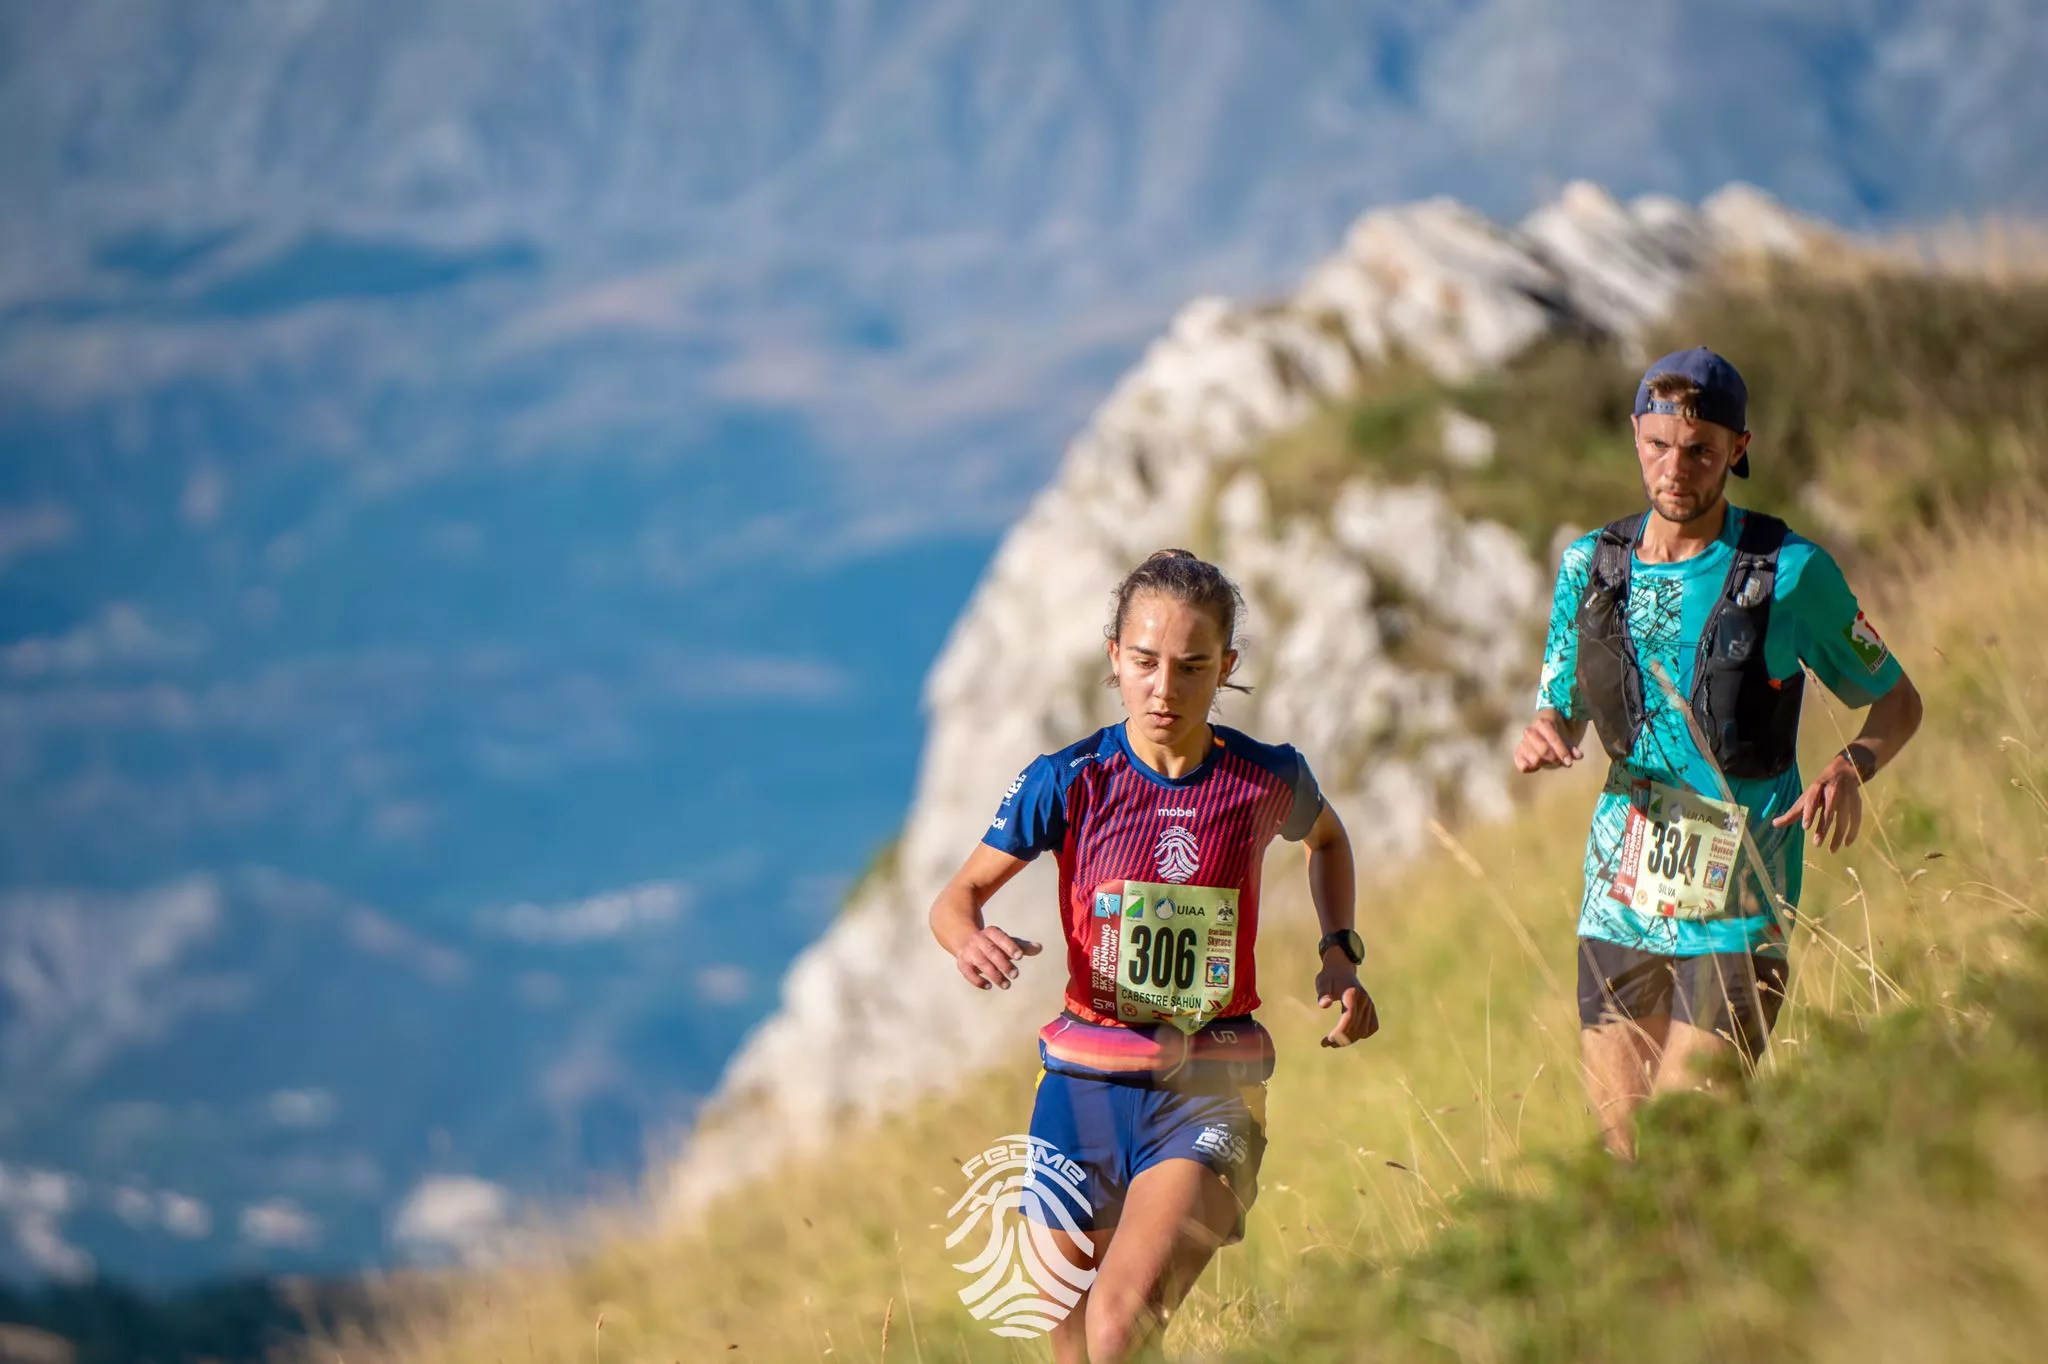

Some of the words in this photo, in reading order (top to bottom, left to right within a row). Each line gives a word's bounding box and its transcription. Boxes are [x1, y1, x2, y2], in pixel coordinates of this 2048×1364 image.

[1158, 807, 1196, 817] mobel
[1648, 821, 1702, 886] 334
[1658, 883, 1676, 897] SILVA
[1177, 905, 1205, 917] UIAA
[1092, 946, 1101, 970] YOUTH
[1099, 923, 1112, 992] SKYRUNNING
[1109, 929, 1118, 962] CHAMPS
[1128, 925, 1197, 990] 306
[1108, 964, 1116, 992] WORLD
[1121, 988, 1169, 1007] CABESTRE
[1171, 992, 1202, 1009] SAHÚN
